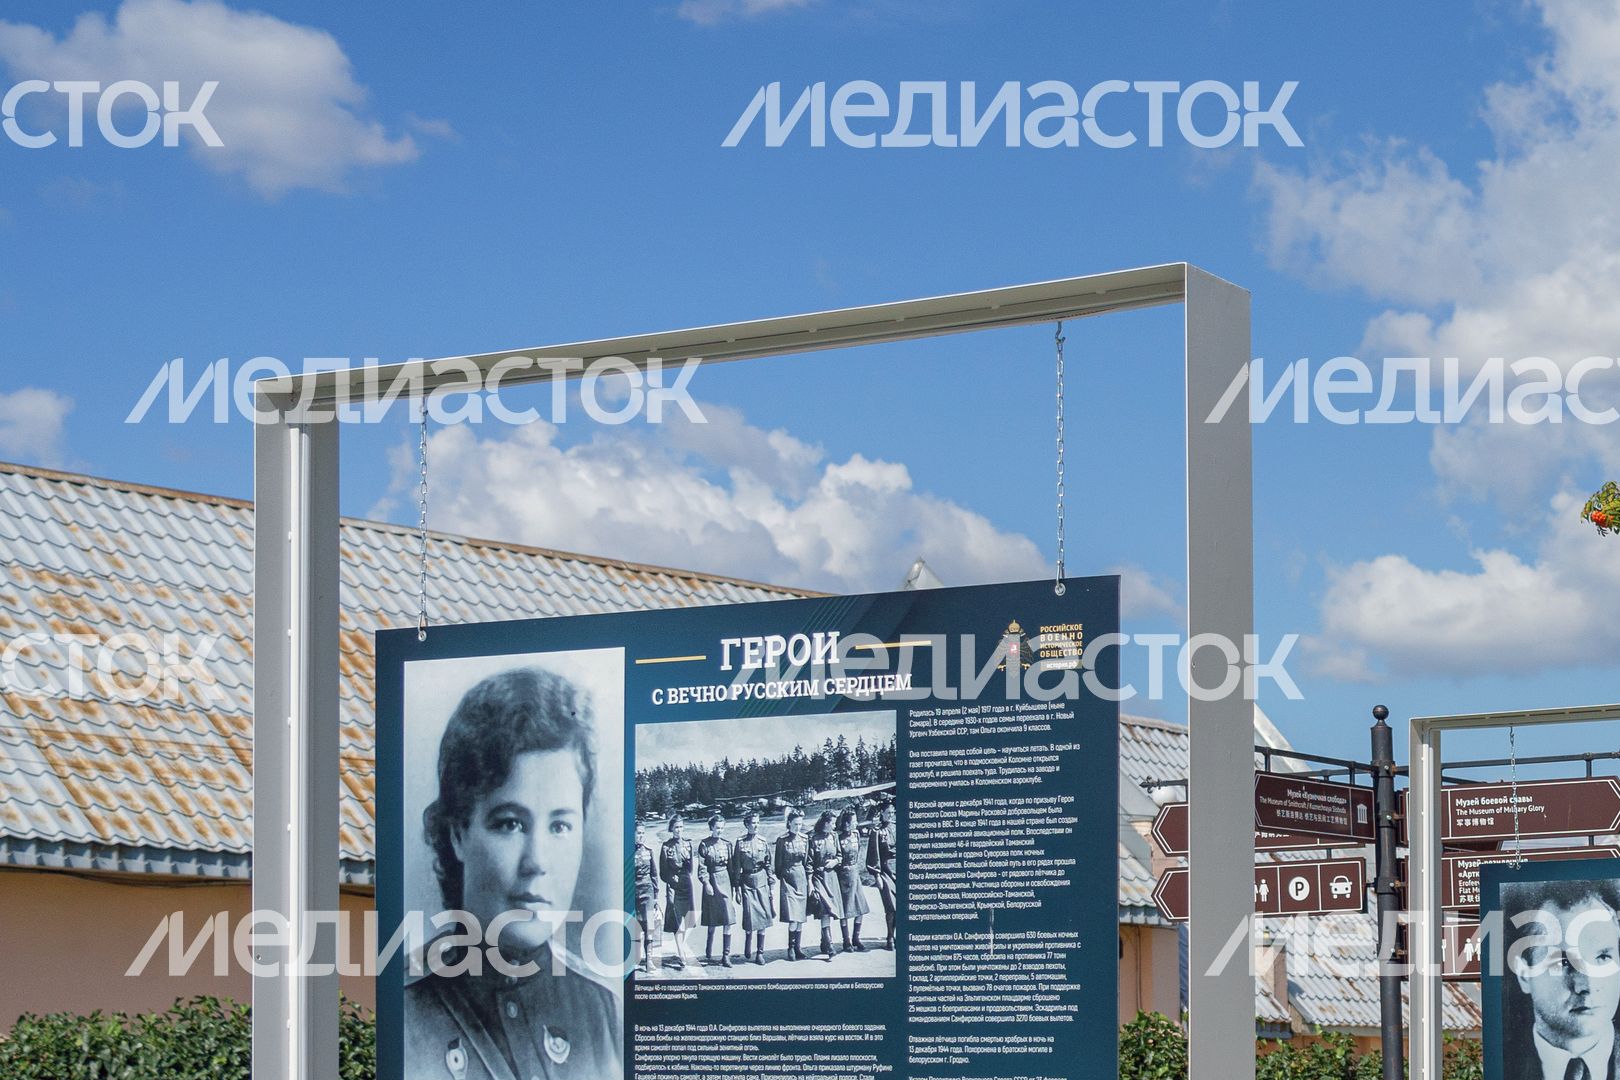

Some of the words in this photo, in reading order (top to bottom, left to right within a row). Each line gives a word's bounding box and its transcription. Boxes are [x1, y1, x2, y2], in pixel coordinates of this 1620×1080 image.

[1040, 623, 1083, 633] РОССИЙСКОЕ
[1040, 632, 1083, 643] ВОЕННО
[720, 631, 841, 671] ГЕРОИ
[1040, 648, 1084, 659] ОБЩЕСТВО
[652, 688, 663, 705] С
[667, 685, 728, 704] ВЕЧНО
[730, 679, 820, 701] РУССКИМ
[823, 673, 913, 698] СЕРДЦЕМ
[909, 750, 920, 758] Она
[920, 750, 948, 758] поставила
[966, 747, 983, 756] собой
[1055, 743, 1073, 752] одной
[1455, 797, 1480, 808] Музей
[1480, 796, 1508, 805] боевой
[1495, 806, 1503, 814] of
[1528, 805, 1545, 813] Glory
[1295, 881, 1304, 896] P
[1028, 1014, 1050, 1022] боевых
